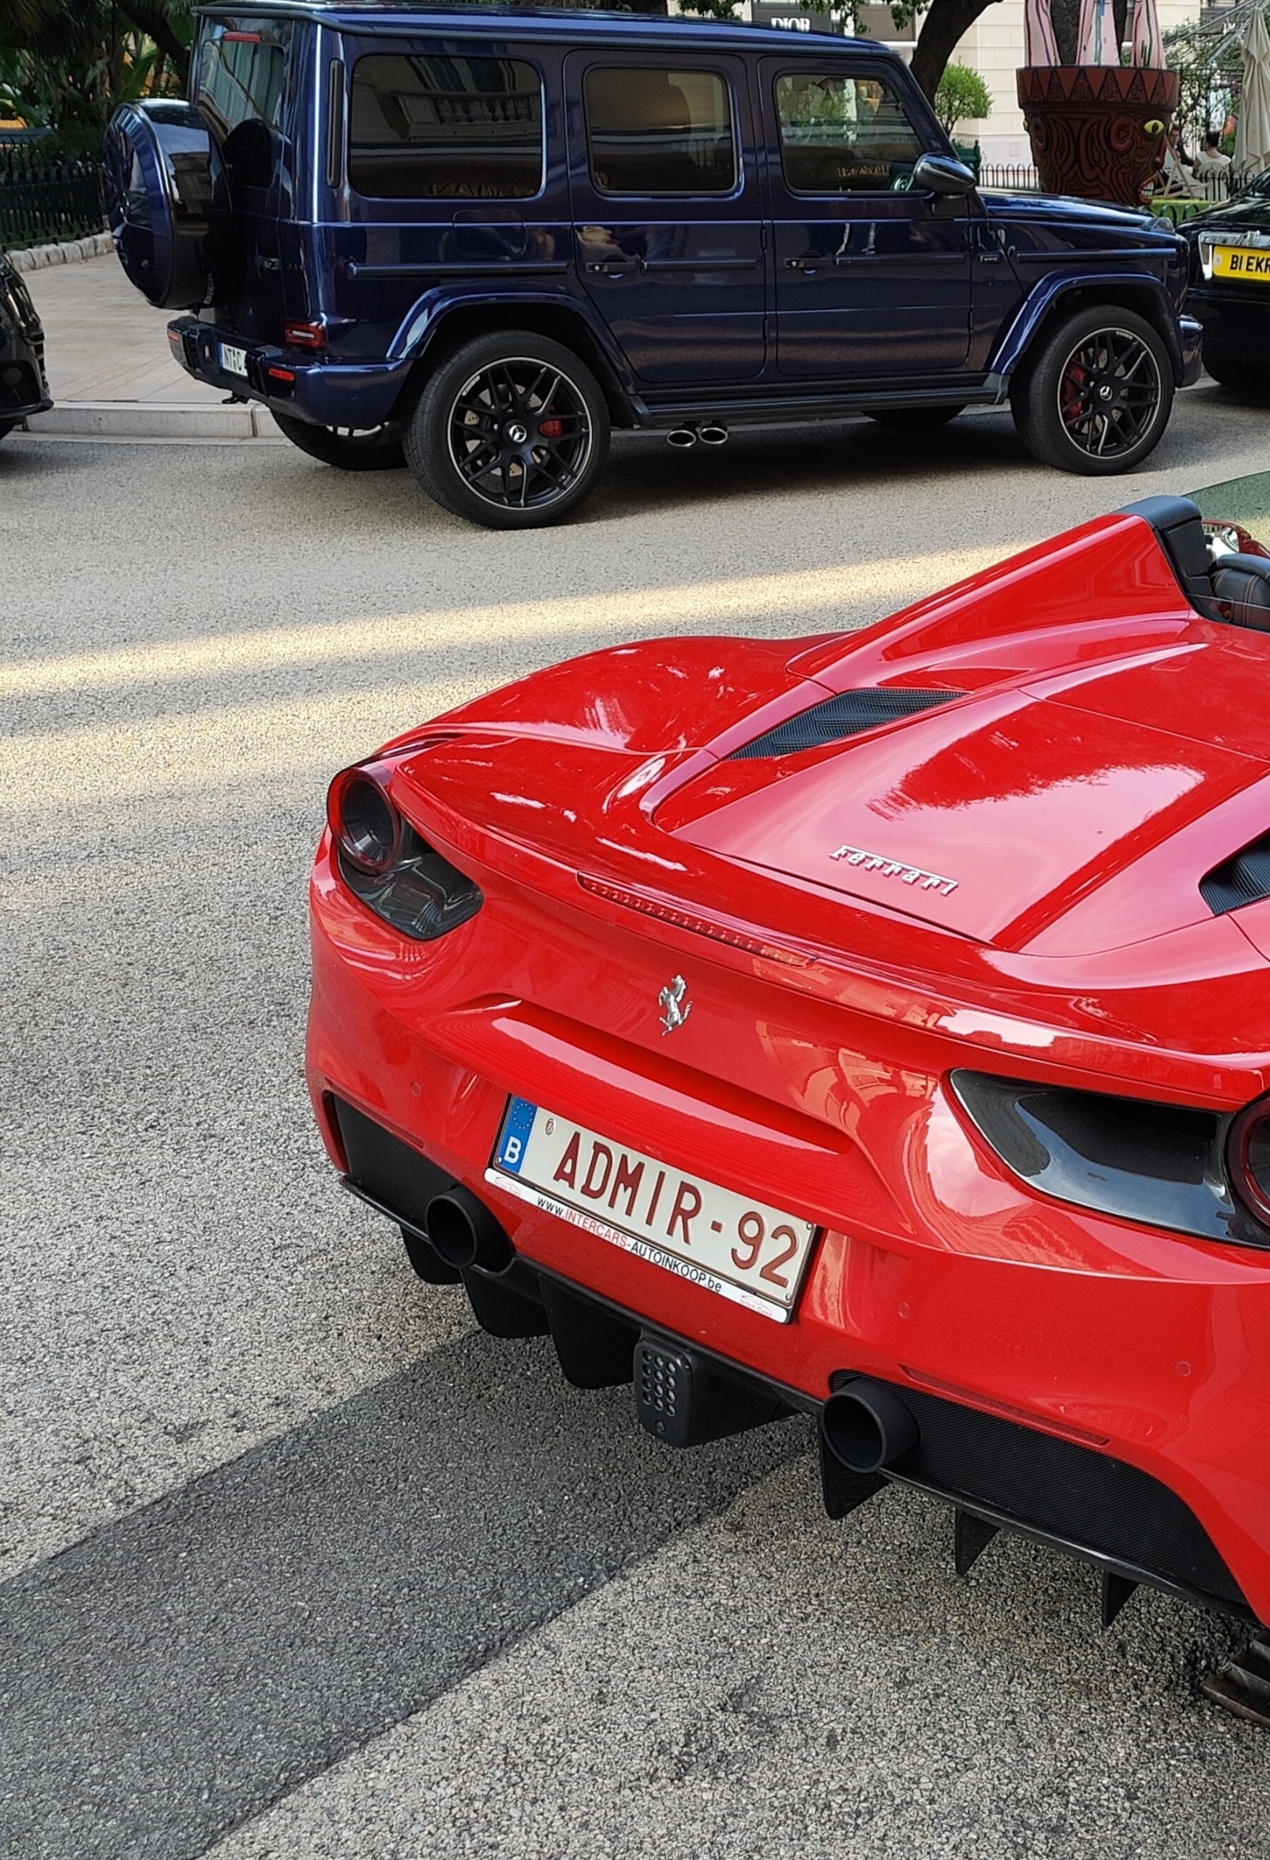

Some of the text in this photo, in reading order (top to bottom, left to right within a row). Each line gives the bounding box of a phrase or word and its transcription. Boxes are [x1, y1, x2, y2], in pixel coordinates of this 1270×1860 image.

[770, 17, 811, 33] DIOR
[828, 843, 959, 897] Ferrari
[504, 1136, 522, 1165] B
[536, 1195, 724, 1294] www.INTERCARS-AUTOINKOOP.be
